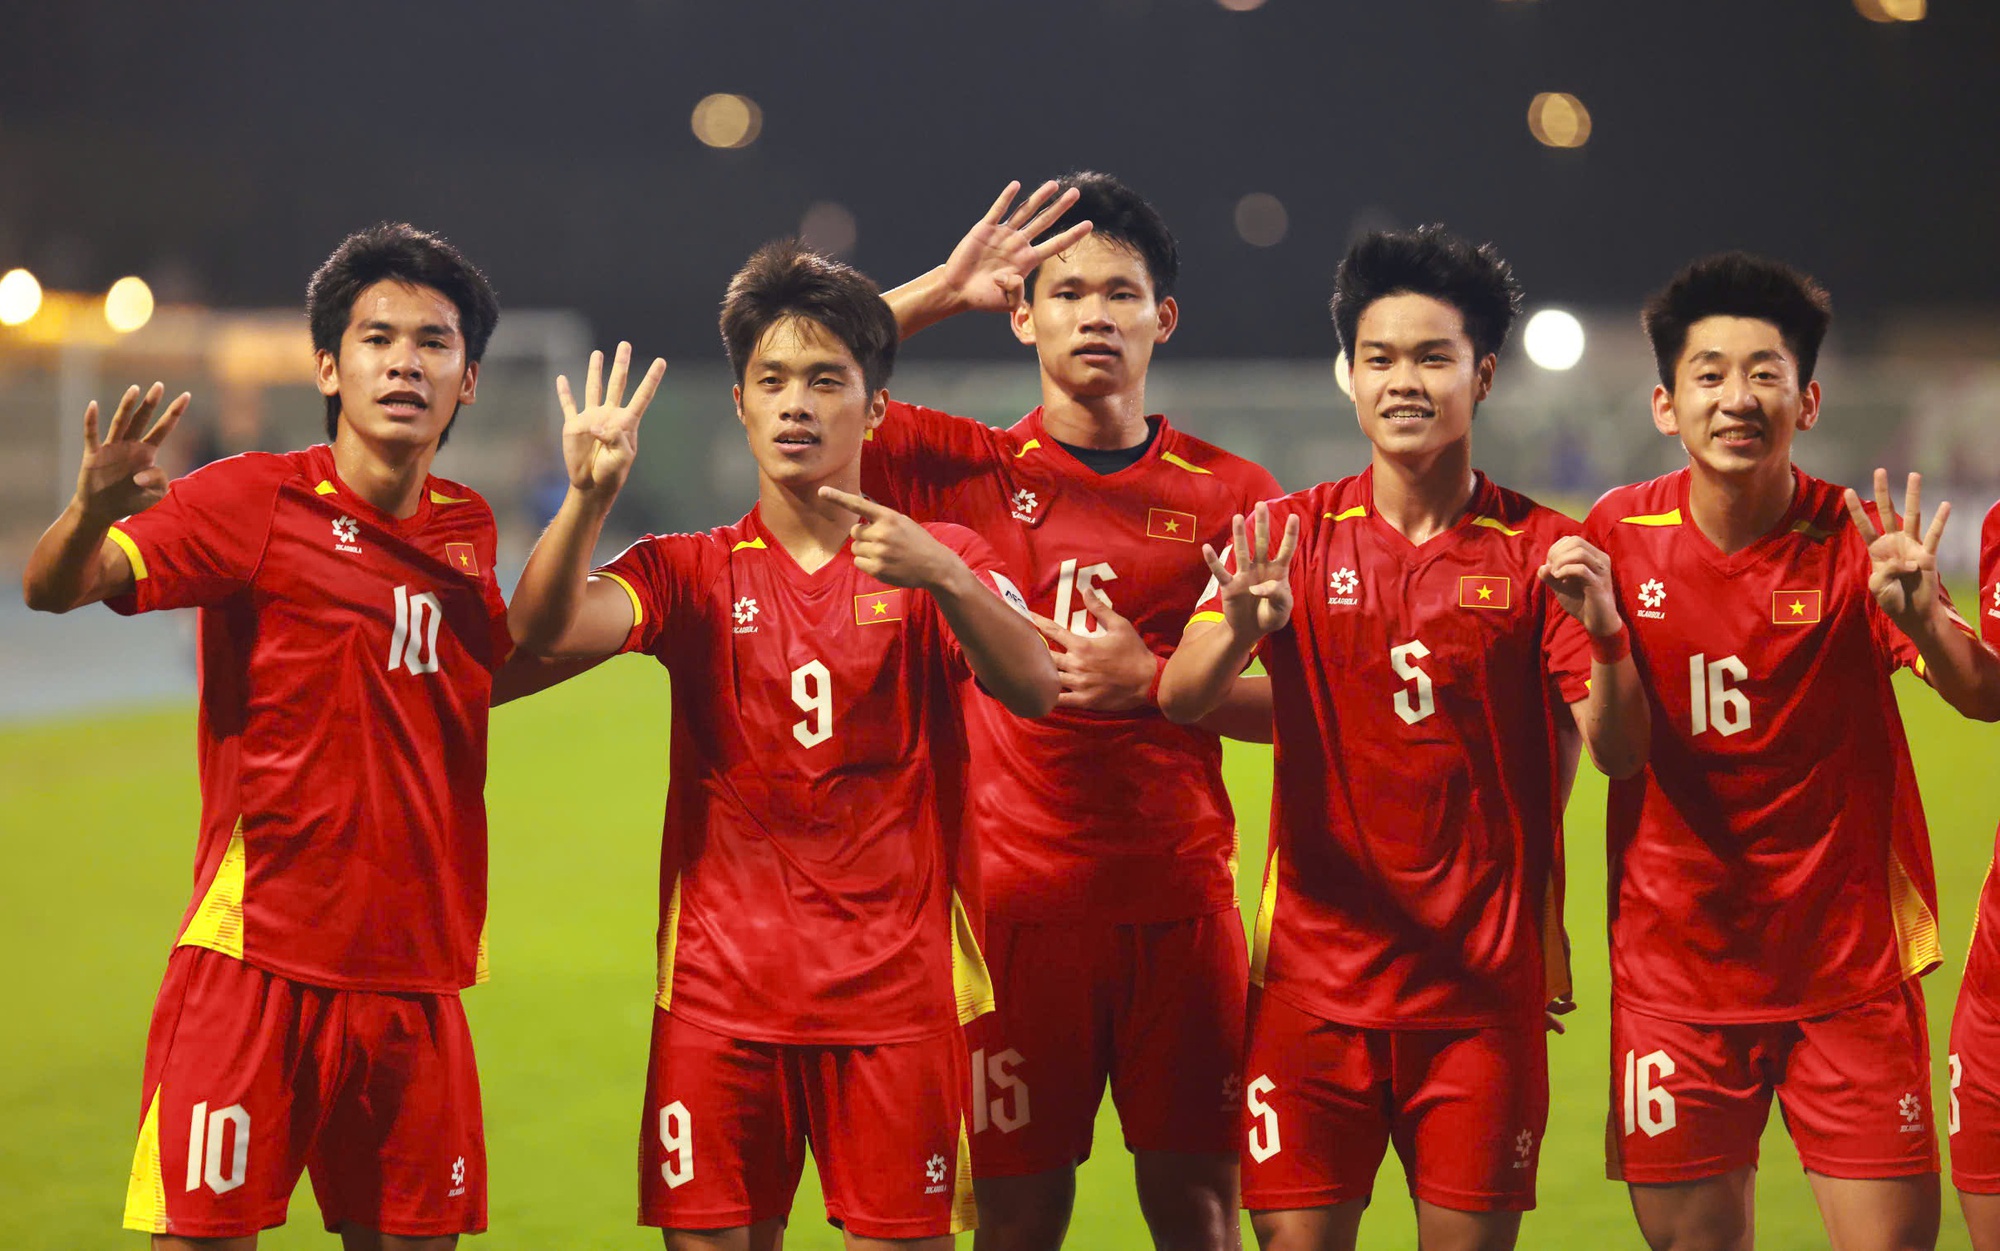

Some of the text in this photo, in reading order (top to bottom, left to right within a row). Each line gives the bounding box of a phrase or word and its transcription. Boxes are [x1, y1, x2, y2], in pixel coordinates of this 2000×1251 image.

[387, 584, 442, 676] 10
[1053, 558, 1119, 639] 15
[791, 658, 833, 750] 9
[1391, 639, 1436, 725] 5
[1689, 652, 1751, 737] 16
[971, 1047, 1031, 1135] 15
[1247, 1074, 1281, 1164] 5
[1623, 1049, 1676, 1138] 16
[185, 1101, 251, 1195] 10
[659, 1100, 694, 1189] 9
